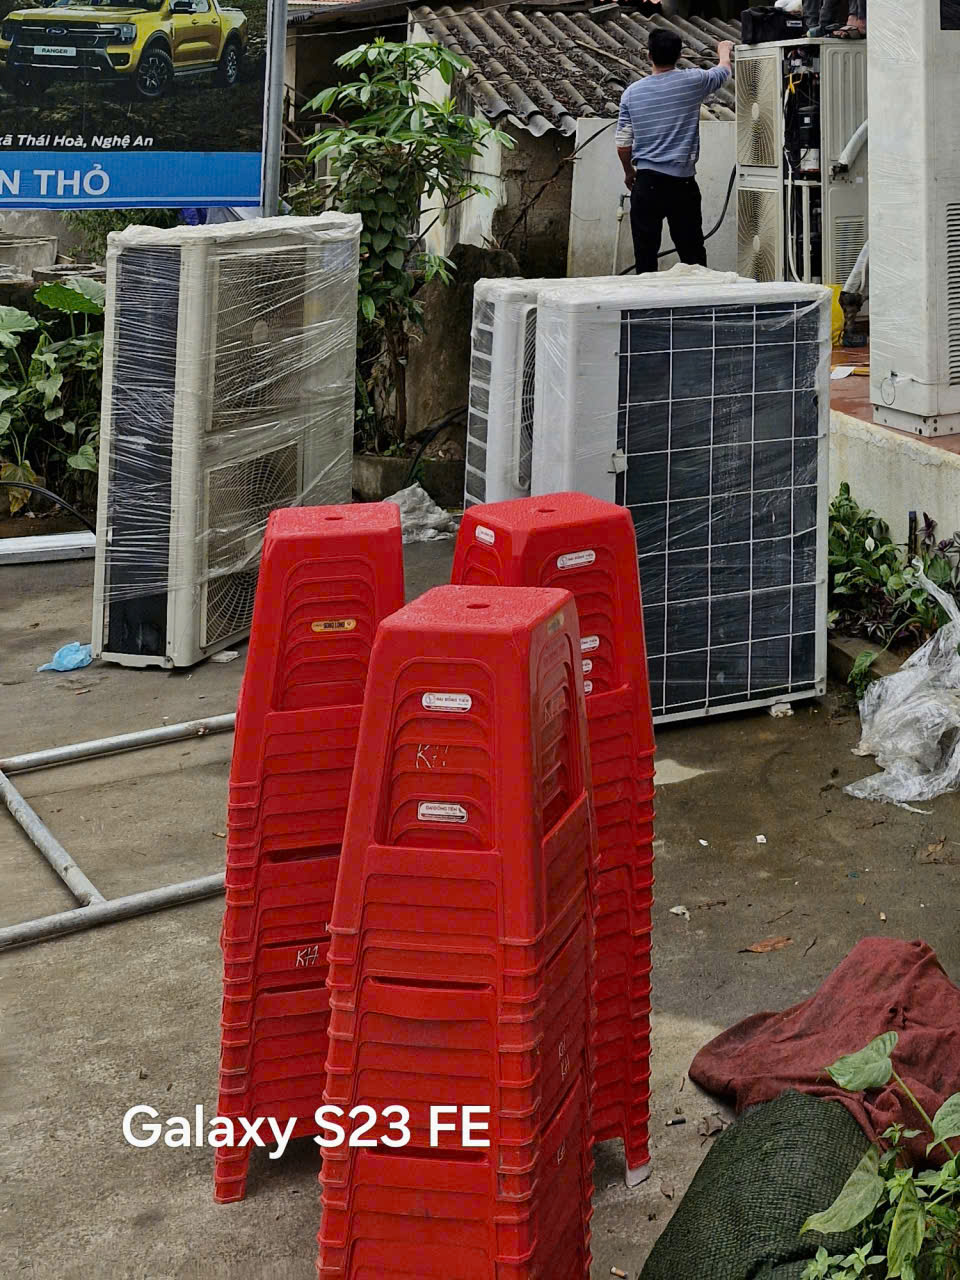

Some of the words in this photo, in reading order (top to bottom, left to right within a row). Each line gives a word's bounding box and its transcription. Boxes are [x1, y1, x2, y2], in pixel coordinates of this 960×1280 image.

[41, 47, 69, 55] RANGER
[17, 134, 50, 147] Thái
[53, 135, 87, 149] Hoà,
[91, 135, 130, 149] Nghệ
[133, 136, 154, 147] An
[33, 164, 110, 196] THỎ
